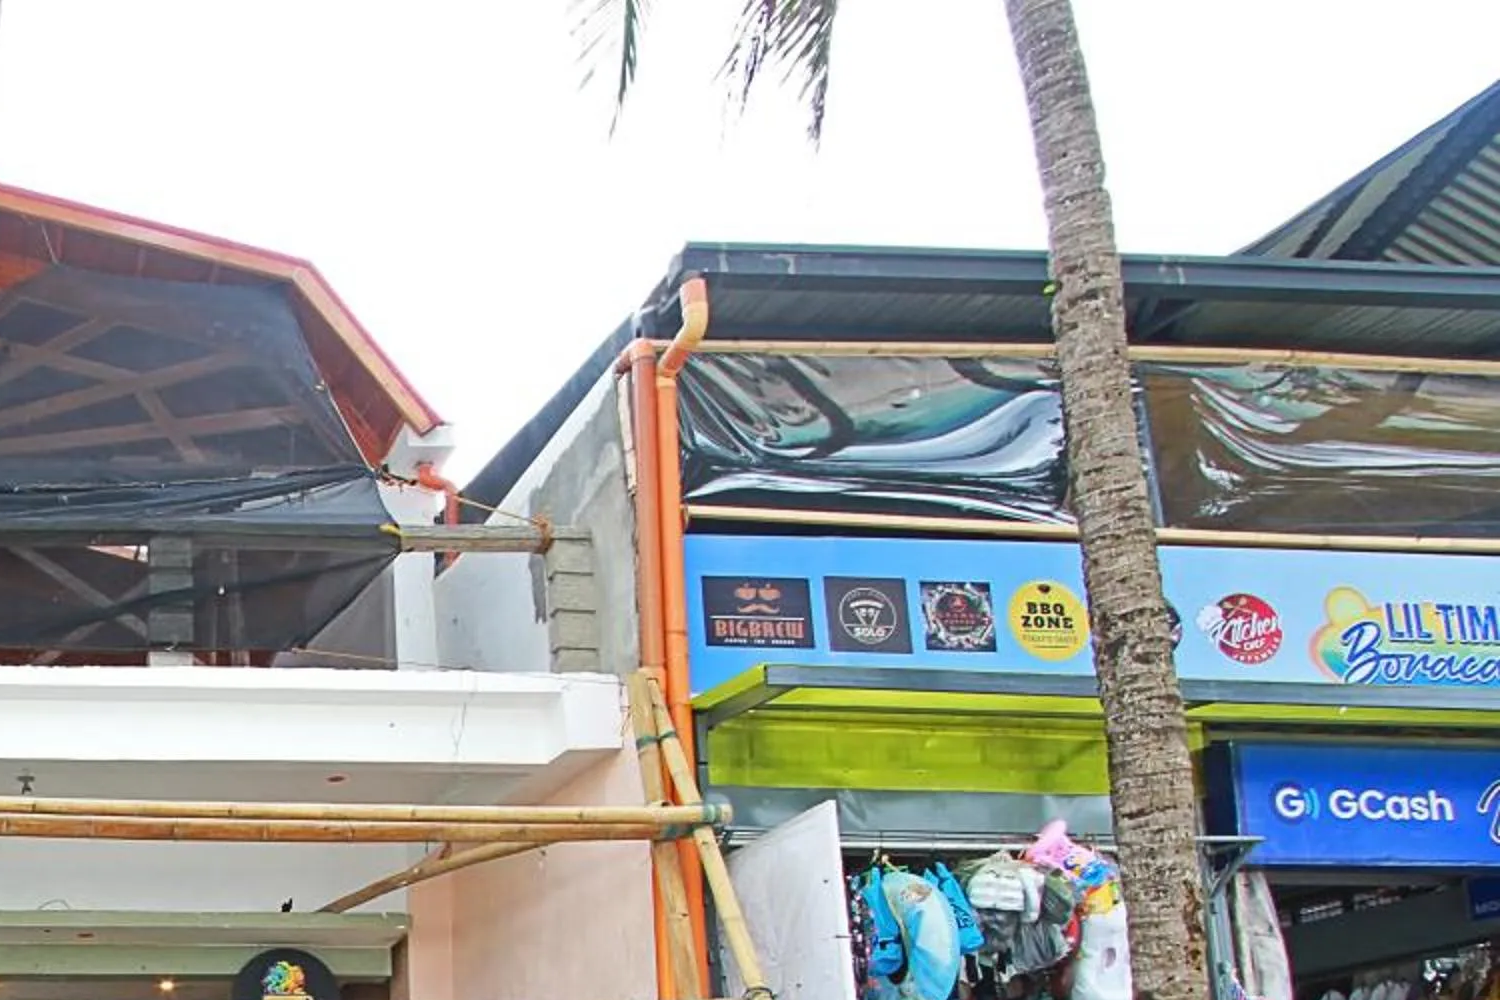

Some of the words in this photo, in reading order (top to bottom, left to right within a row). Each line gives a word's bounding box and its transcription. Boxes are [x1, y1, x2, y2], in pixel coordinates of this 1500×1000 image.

[1021, 615, 1074, 630] ZONE
[1026, 601, 1066, 617] BBQ
[1384, 602, 1433, 640] LIL
[1208, 612, 1279, 649] Kitchen
[1328, 789, 1455, 822] GCash
